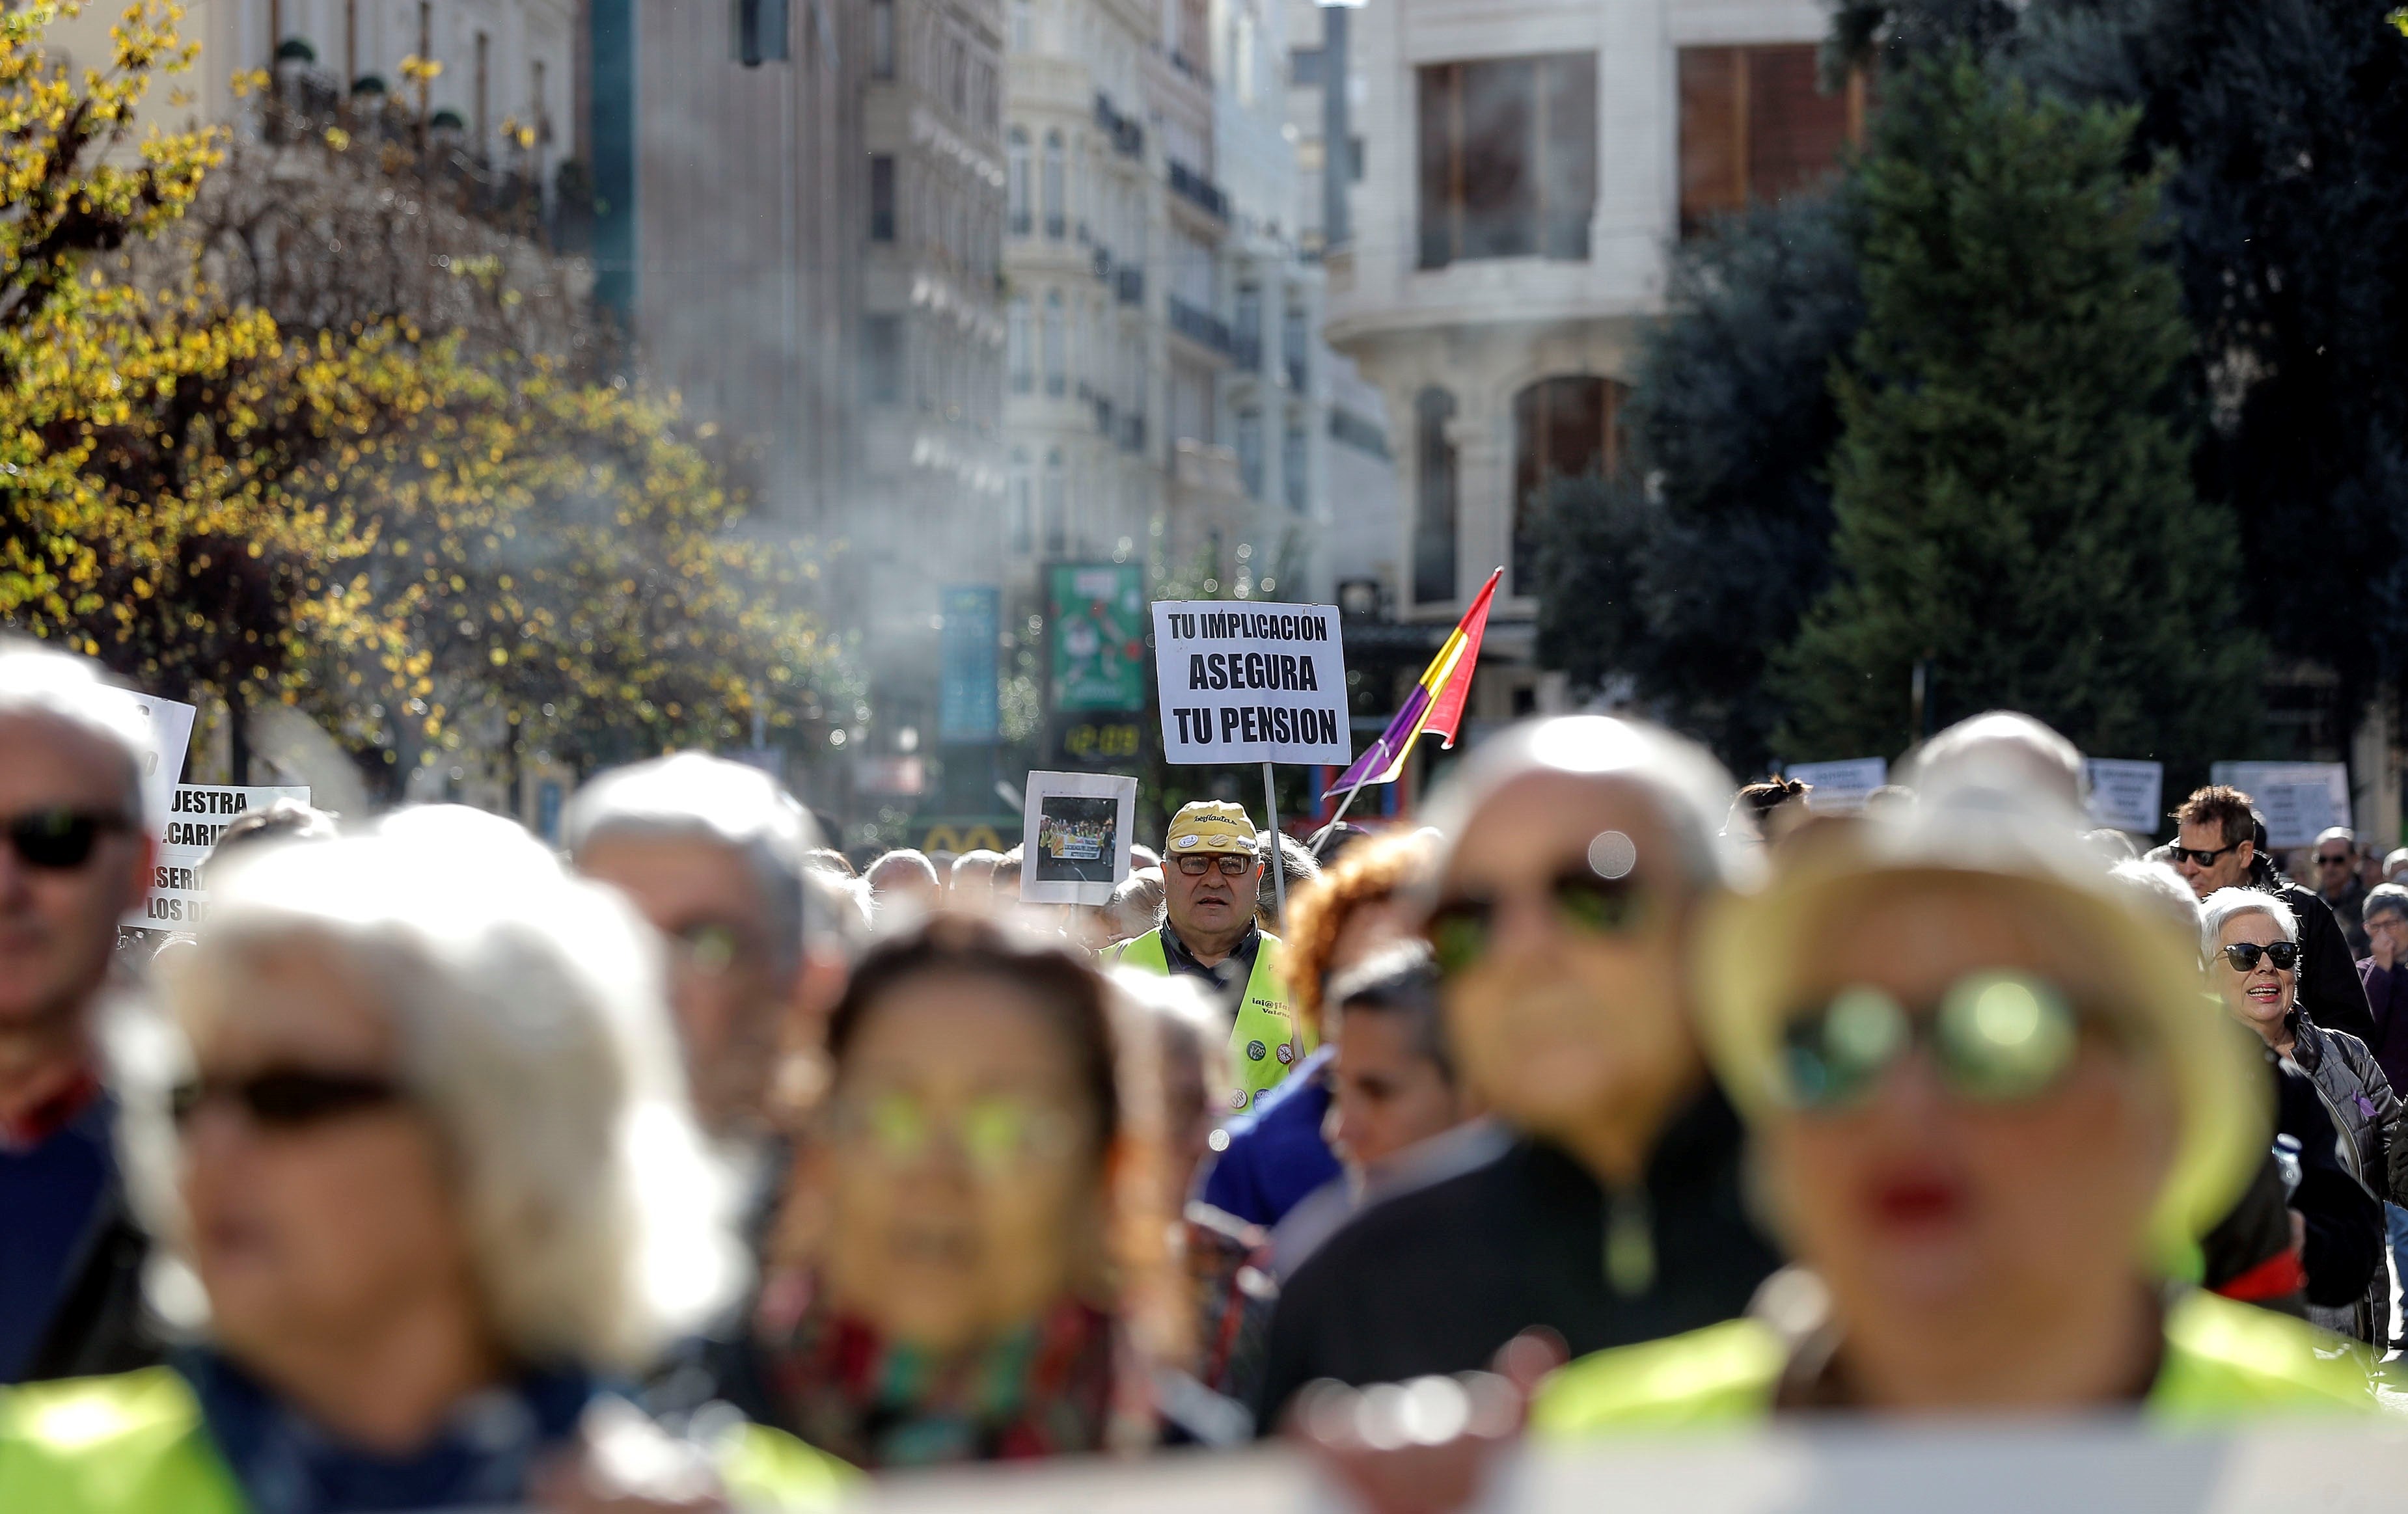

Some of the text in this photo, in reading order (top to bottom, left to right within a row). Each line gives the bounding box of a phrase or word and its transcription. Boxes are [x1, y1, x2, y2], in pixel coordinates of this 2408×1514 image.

[1168, 613, 1328, 642] TU IMPLICACION
[1189, 653, 1319, 691] ASEGURA
[1173, 707, 1338, 744] TU PENSION
[147, 897, 182, 921] LOS
